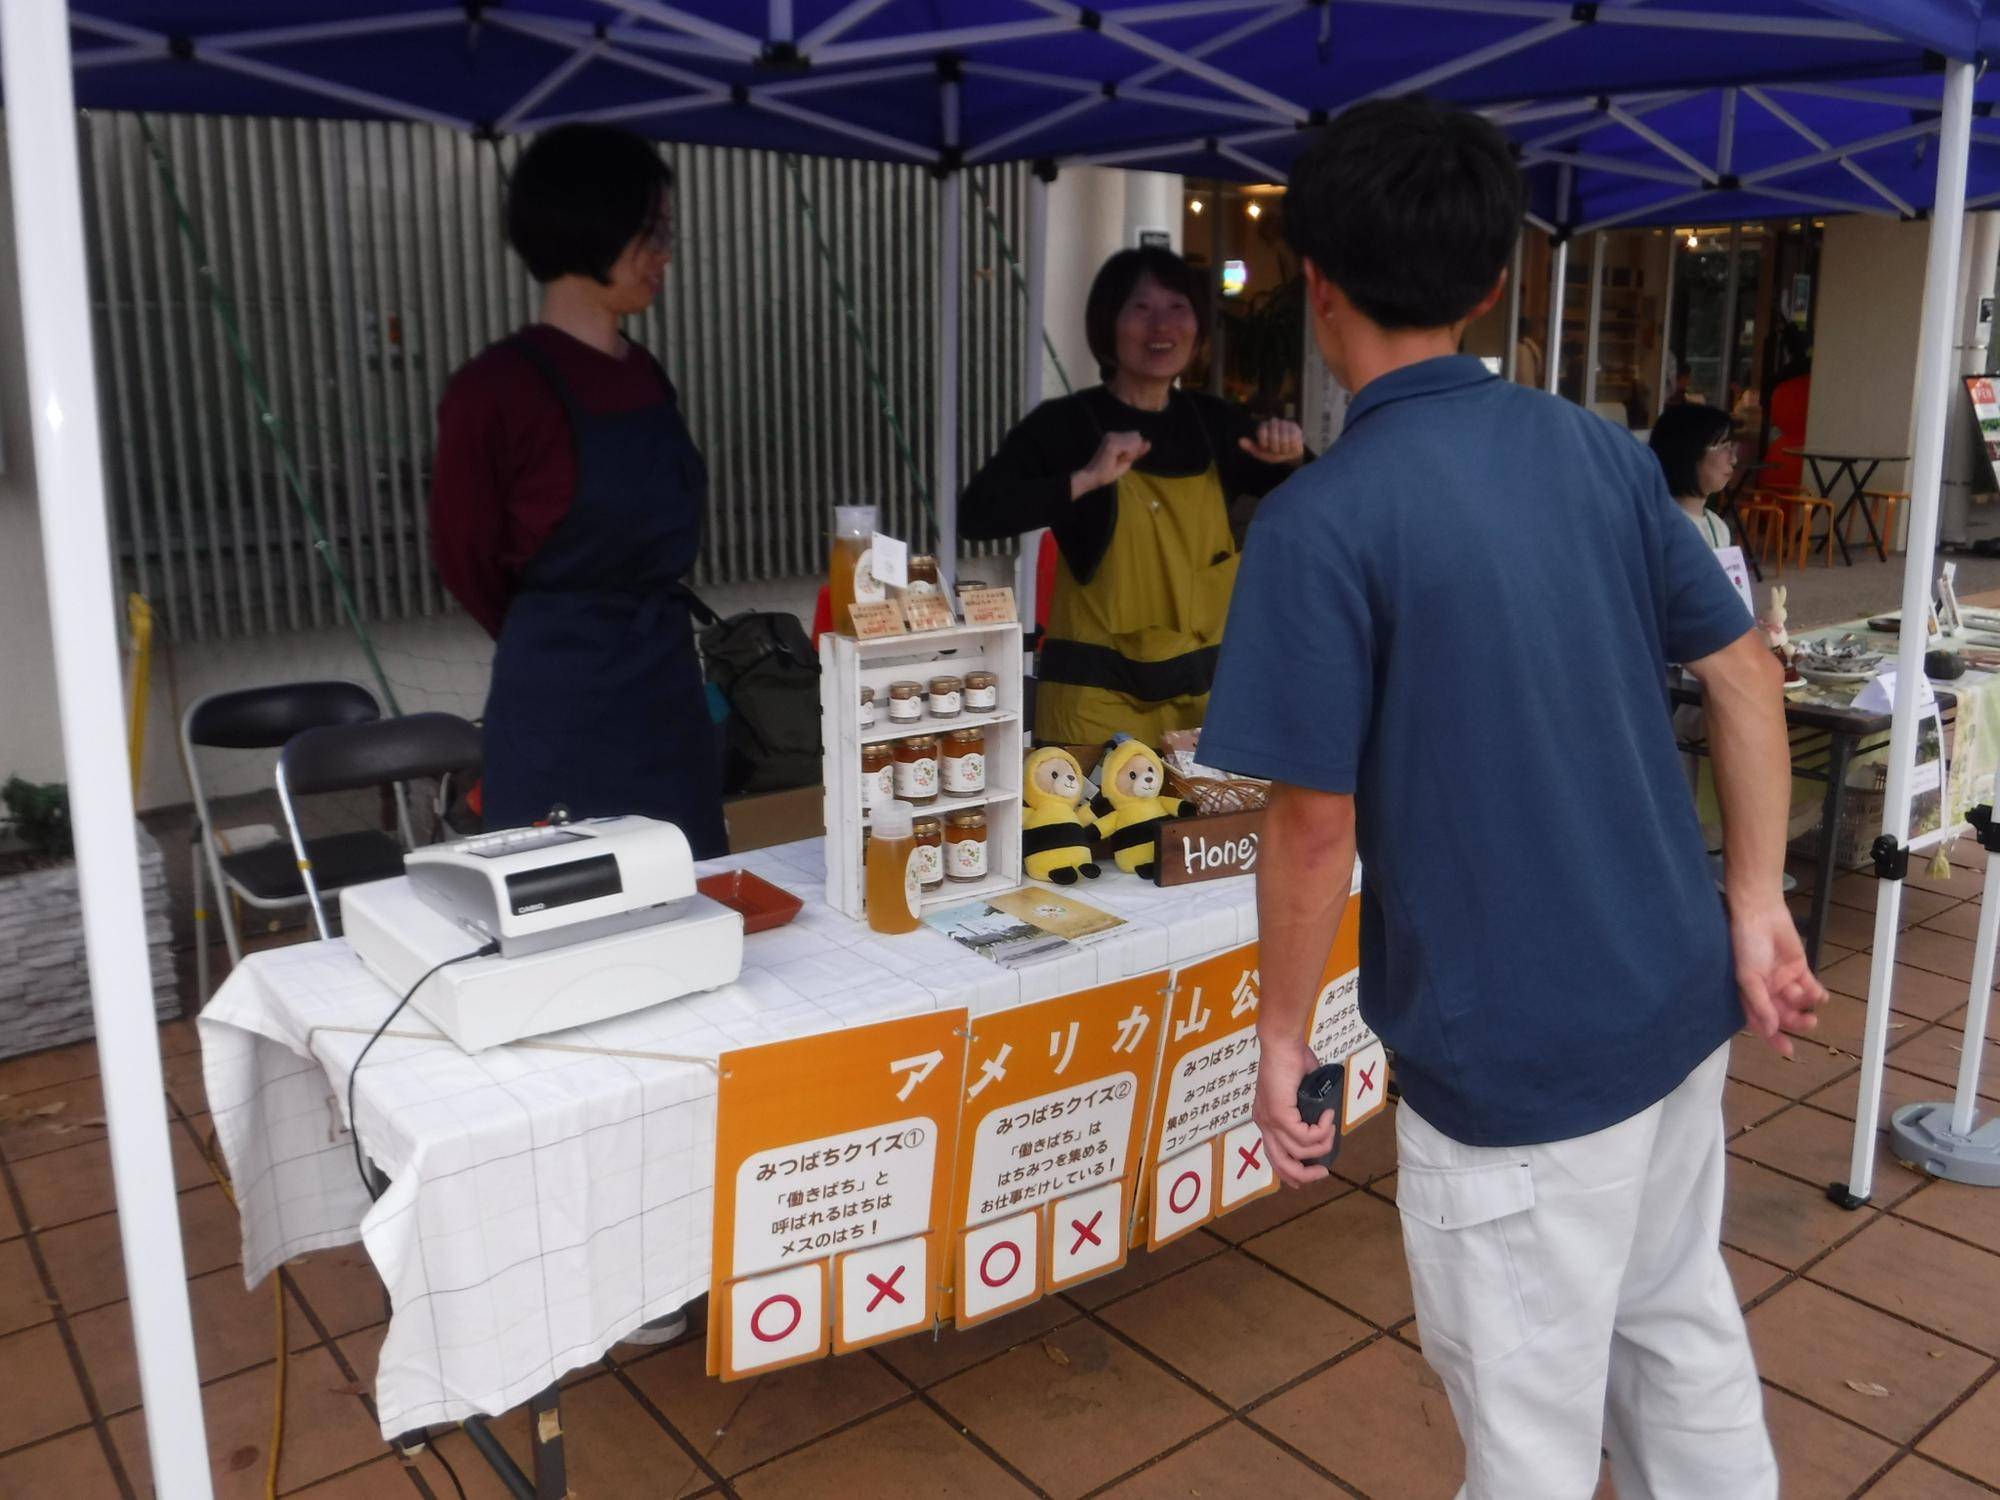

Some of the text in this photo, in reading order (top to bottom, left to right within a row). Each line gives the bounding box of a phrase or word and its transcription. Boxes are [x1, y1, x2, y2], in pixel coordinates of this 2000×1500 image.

[996, 1080, 1132, 1135] みつばちクイズ②
[1165, 1101, 1254, 1151] コップ一杯分であ
[756, 1127, 925, 1181] みつばちクイズ①
[997, 1139, 1108, 1187] はちみつを集める
[771, 1194, 893, 1235] 呼ばれるはちは
